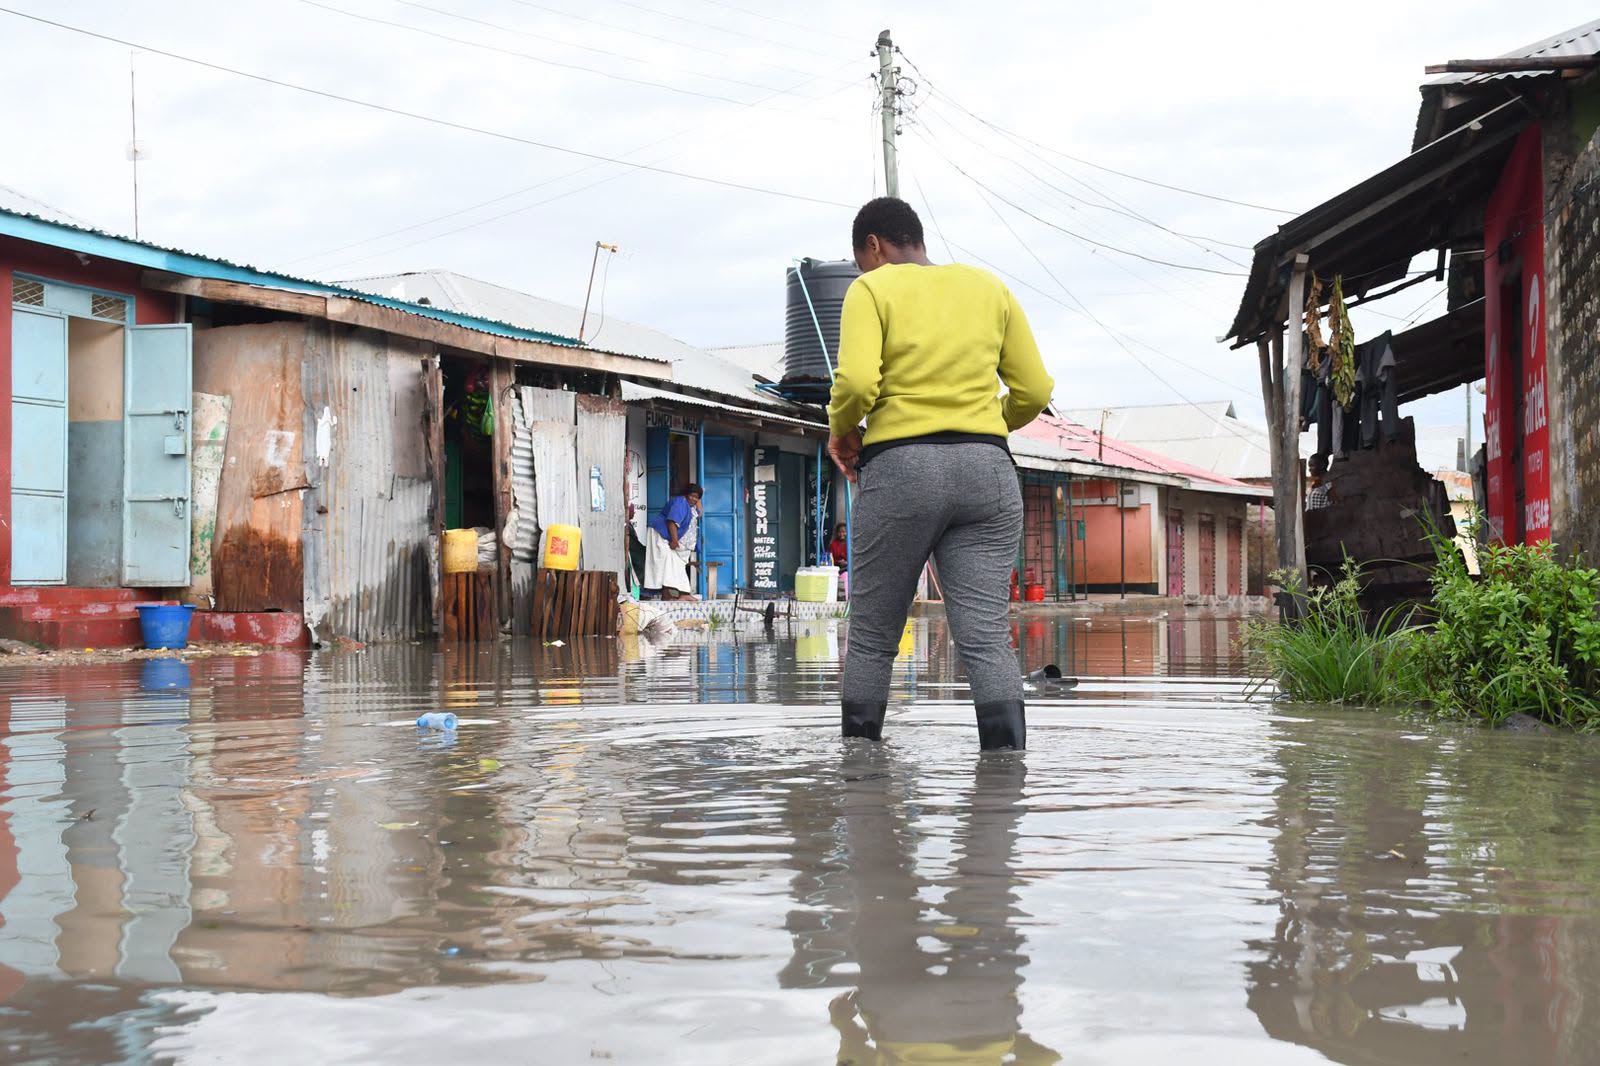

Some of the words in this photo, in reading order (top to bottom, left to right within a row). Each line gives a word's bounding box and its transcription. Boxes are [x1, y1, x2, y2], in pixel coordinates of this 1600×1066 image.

[1525, 364, 1546, 436] airtel
[753, 536, 775, 545] WATER
[753, 545, 771, 553] COLD
